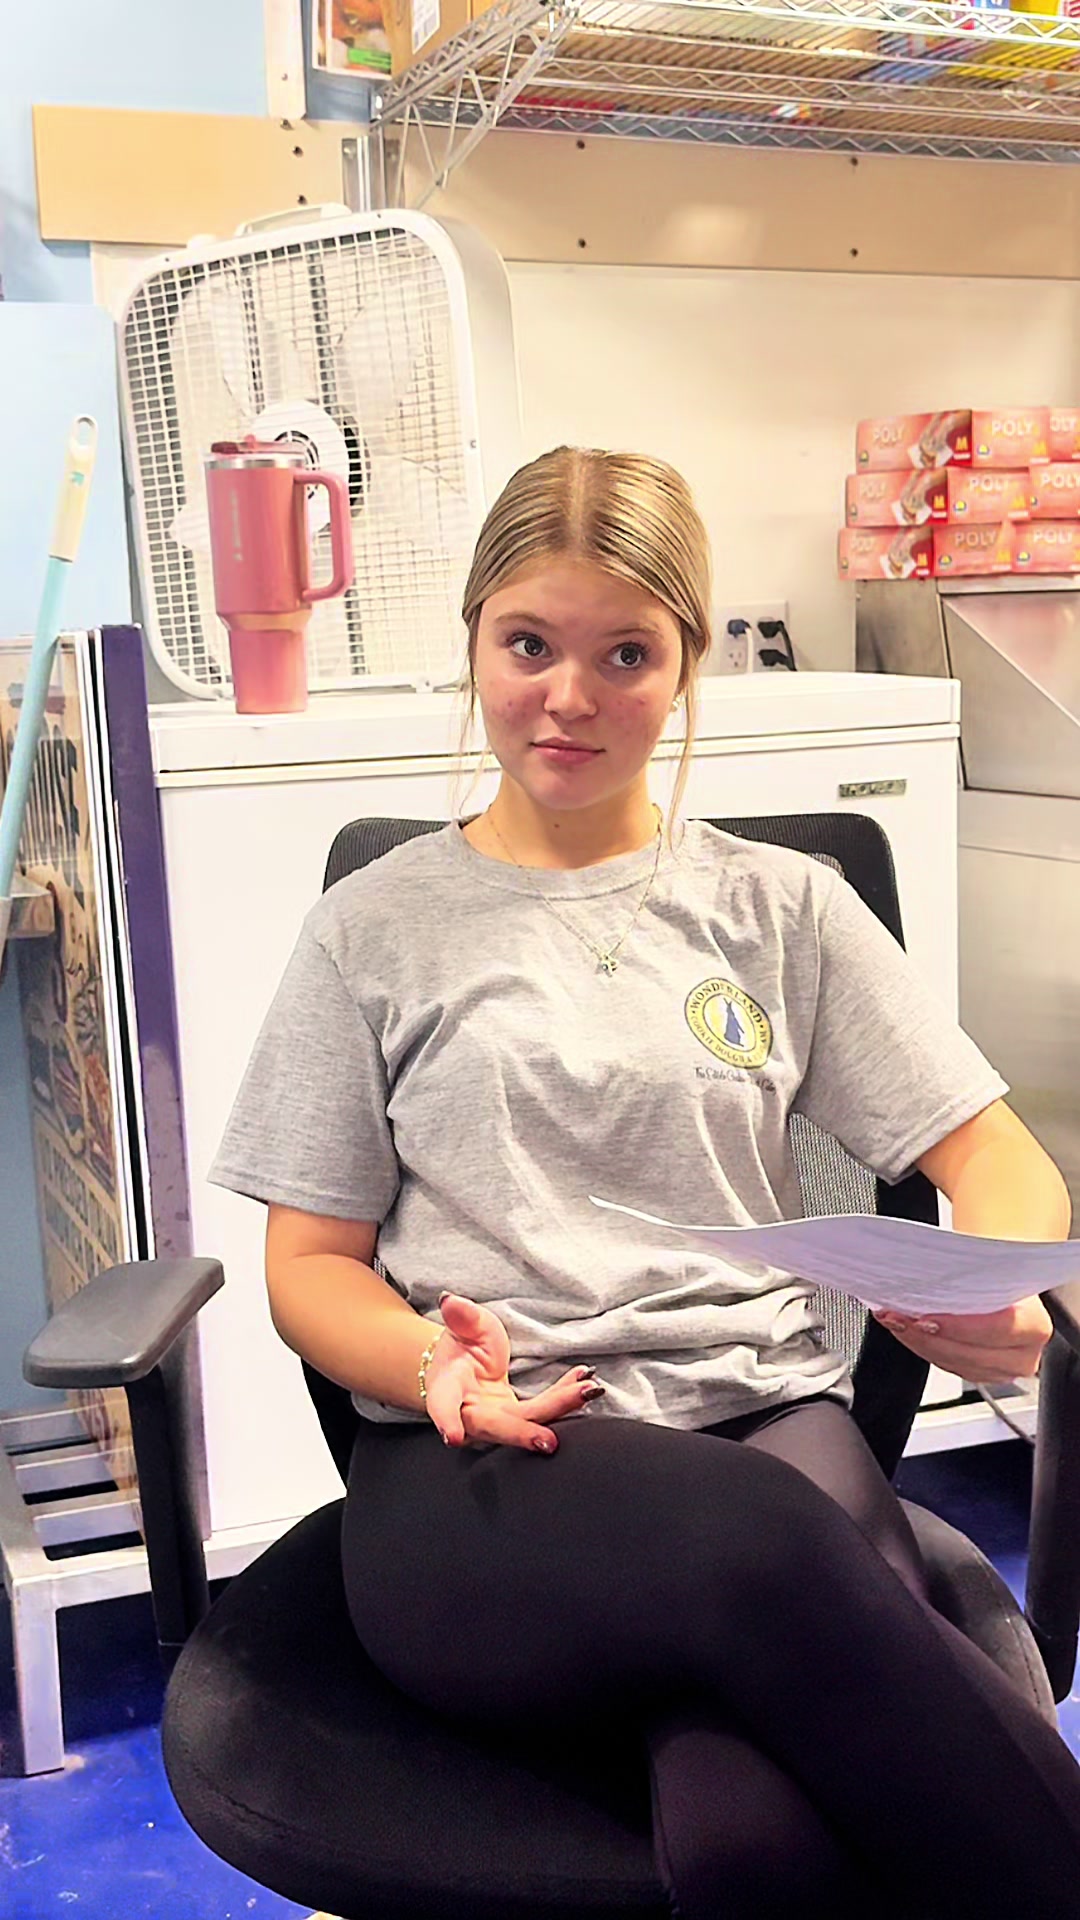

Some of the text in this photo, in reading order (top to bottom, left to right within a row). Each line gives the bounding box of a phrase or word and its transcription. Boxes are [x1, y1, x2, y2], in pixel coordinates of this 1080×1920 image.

[991, 419, 1034, 437] POLY
[1050, 416, 1077, 432] OLY
[1040, 472, 1080, 489] POLY
[954, 531, 996, 548] POLY
